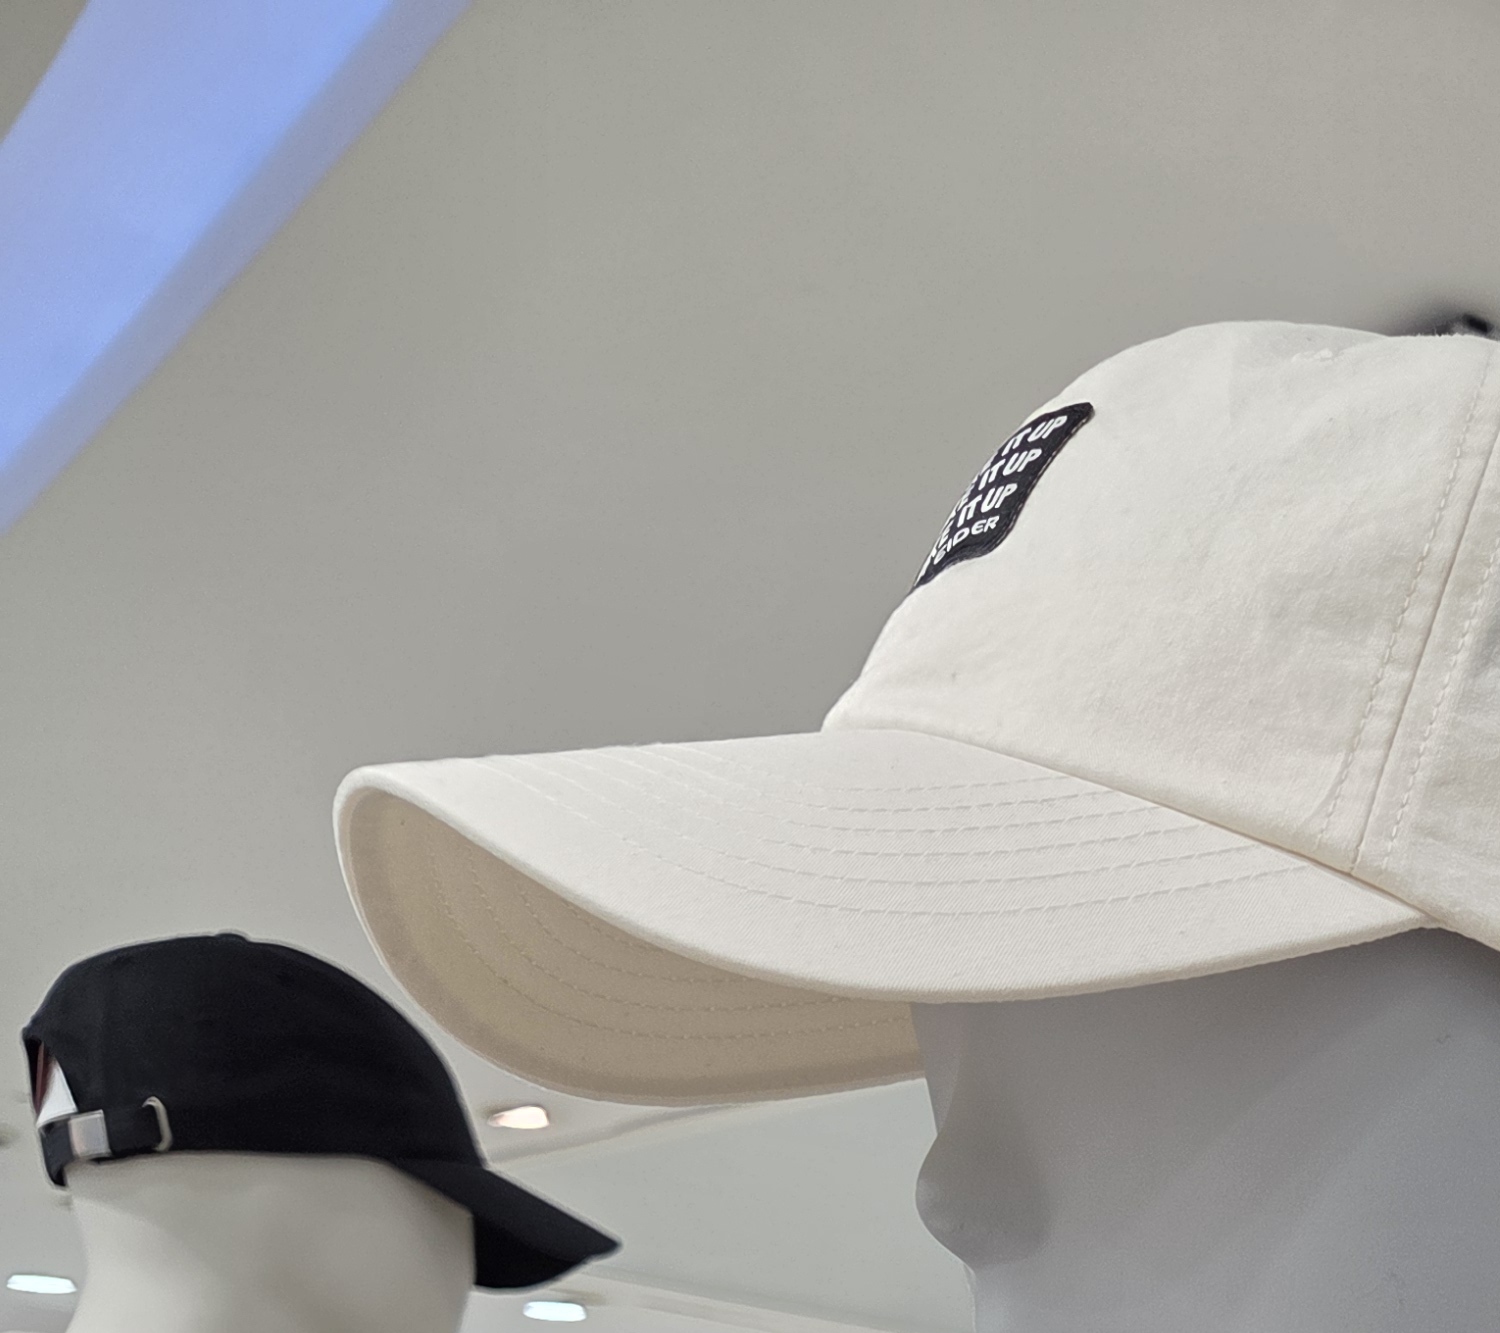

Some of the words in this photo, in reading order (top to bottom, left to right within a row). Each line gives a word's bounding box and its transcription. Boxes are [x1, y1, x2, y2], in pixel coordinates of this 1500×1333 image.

[1001, 427, 1032, 457] IT
[1027, 415, 1068, 443] UP
[978, 459, 1006, 491] IT
[1002, 448, 1043, 477] UP
[956, 494, 983, 528] IT
[980, 483, 1018, 514] UP
